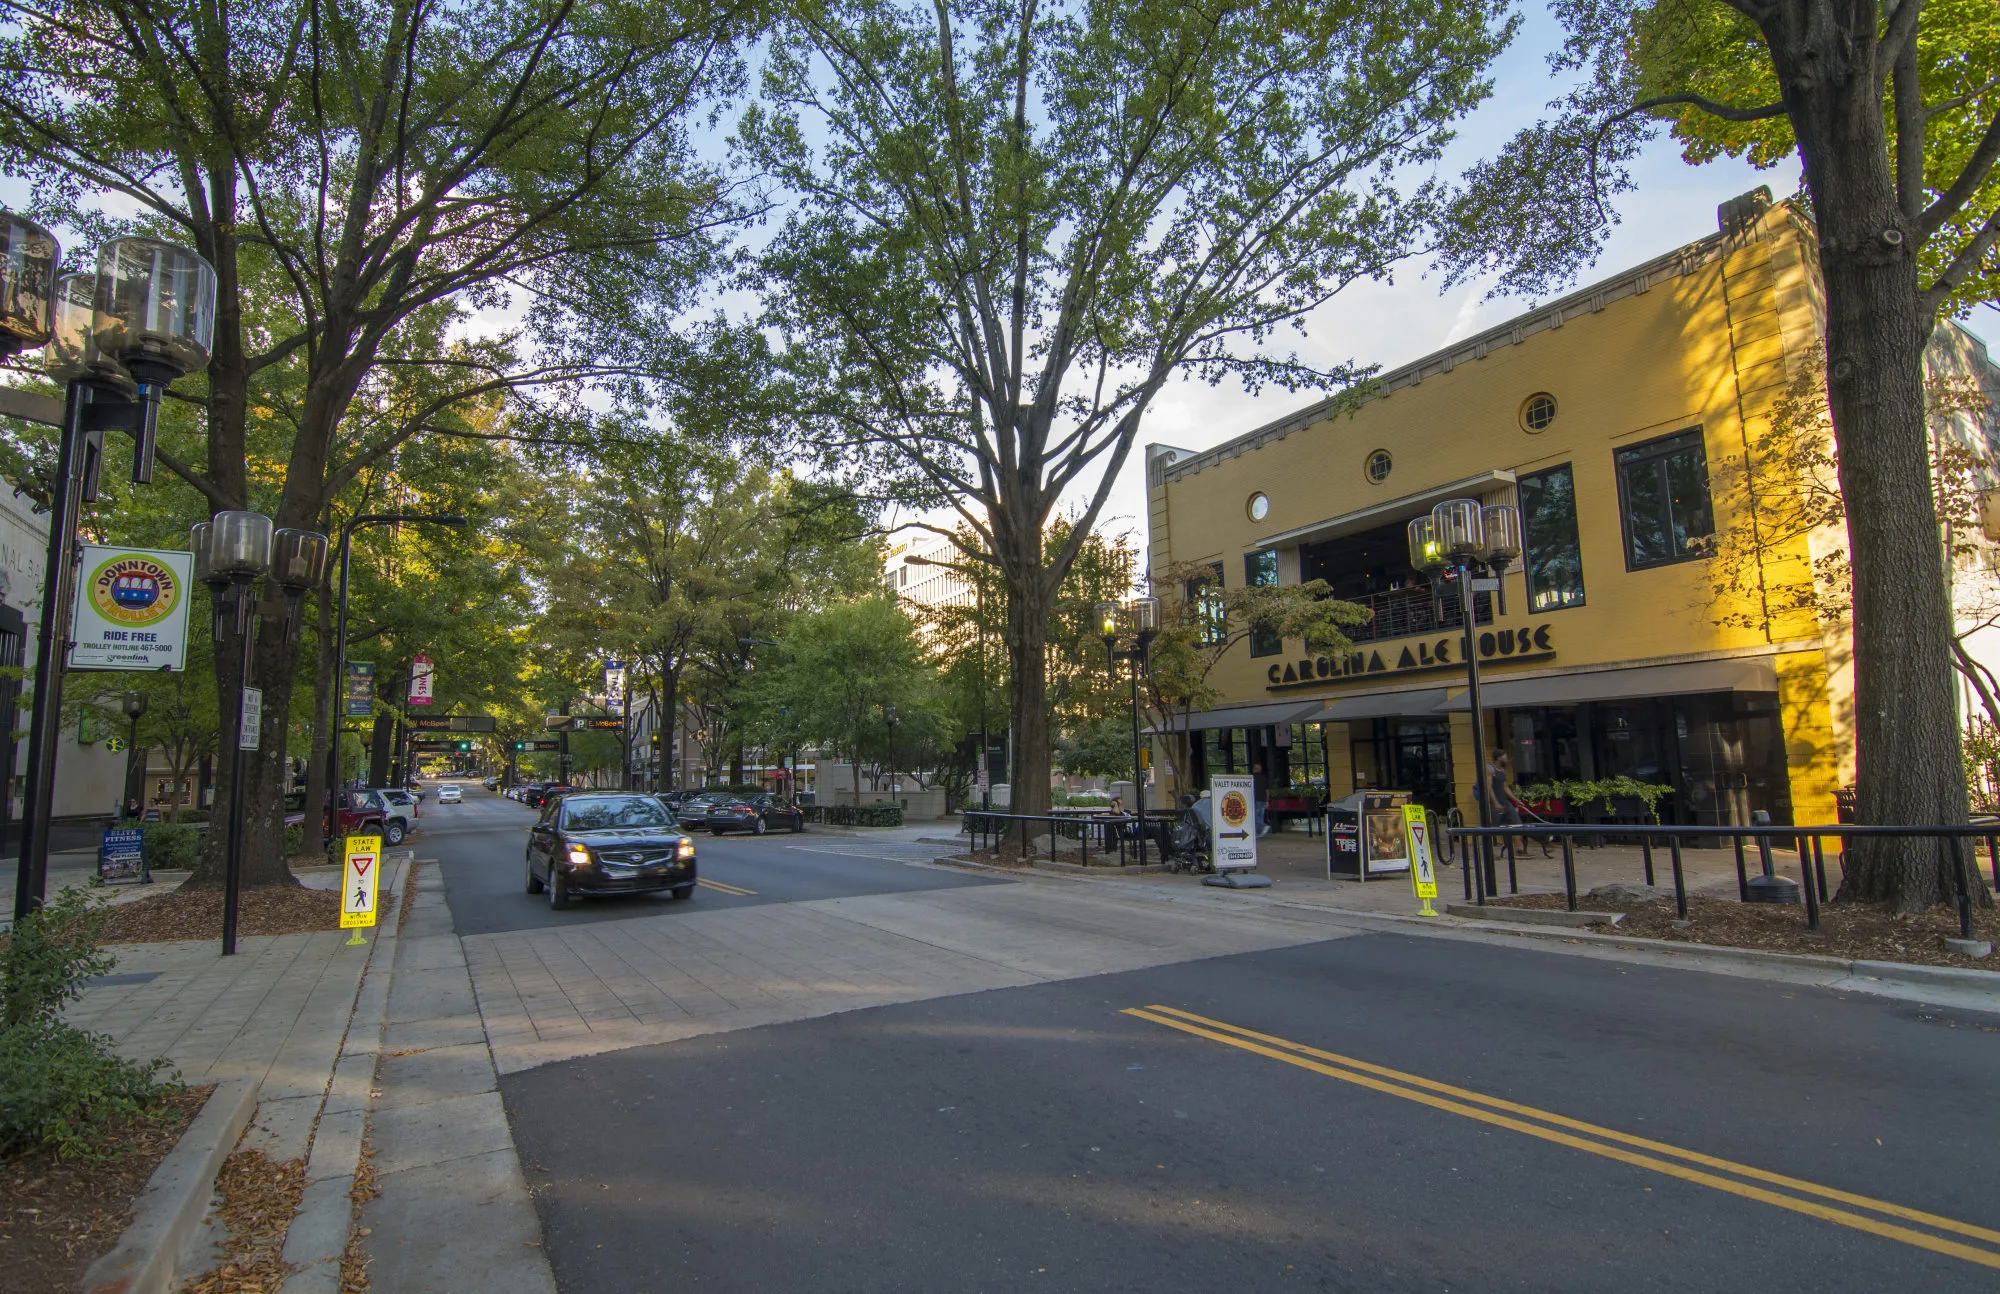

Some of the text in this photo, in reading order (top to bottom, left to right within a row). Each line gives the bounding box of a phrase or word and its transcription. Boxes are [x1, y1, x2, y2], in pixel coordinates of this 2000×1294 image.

[98, 561, 173, 590] DOWNTOWN
[102, 599, 167, 621] TROLLEY
[103, 631, 157, 642] RIDE FREE
[1268, 650, 1387, 684] CAROLINA
[1397, 639, 1451, 669] ALE
[105, 835, 142, 843] FITNESS
